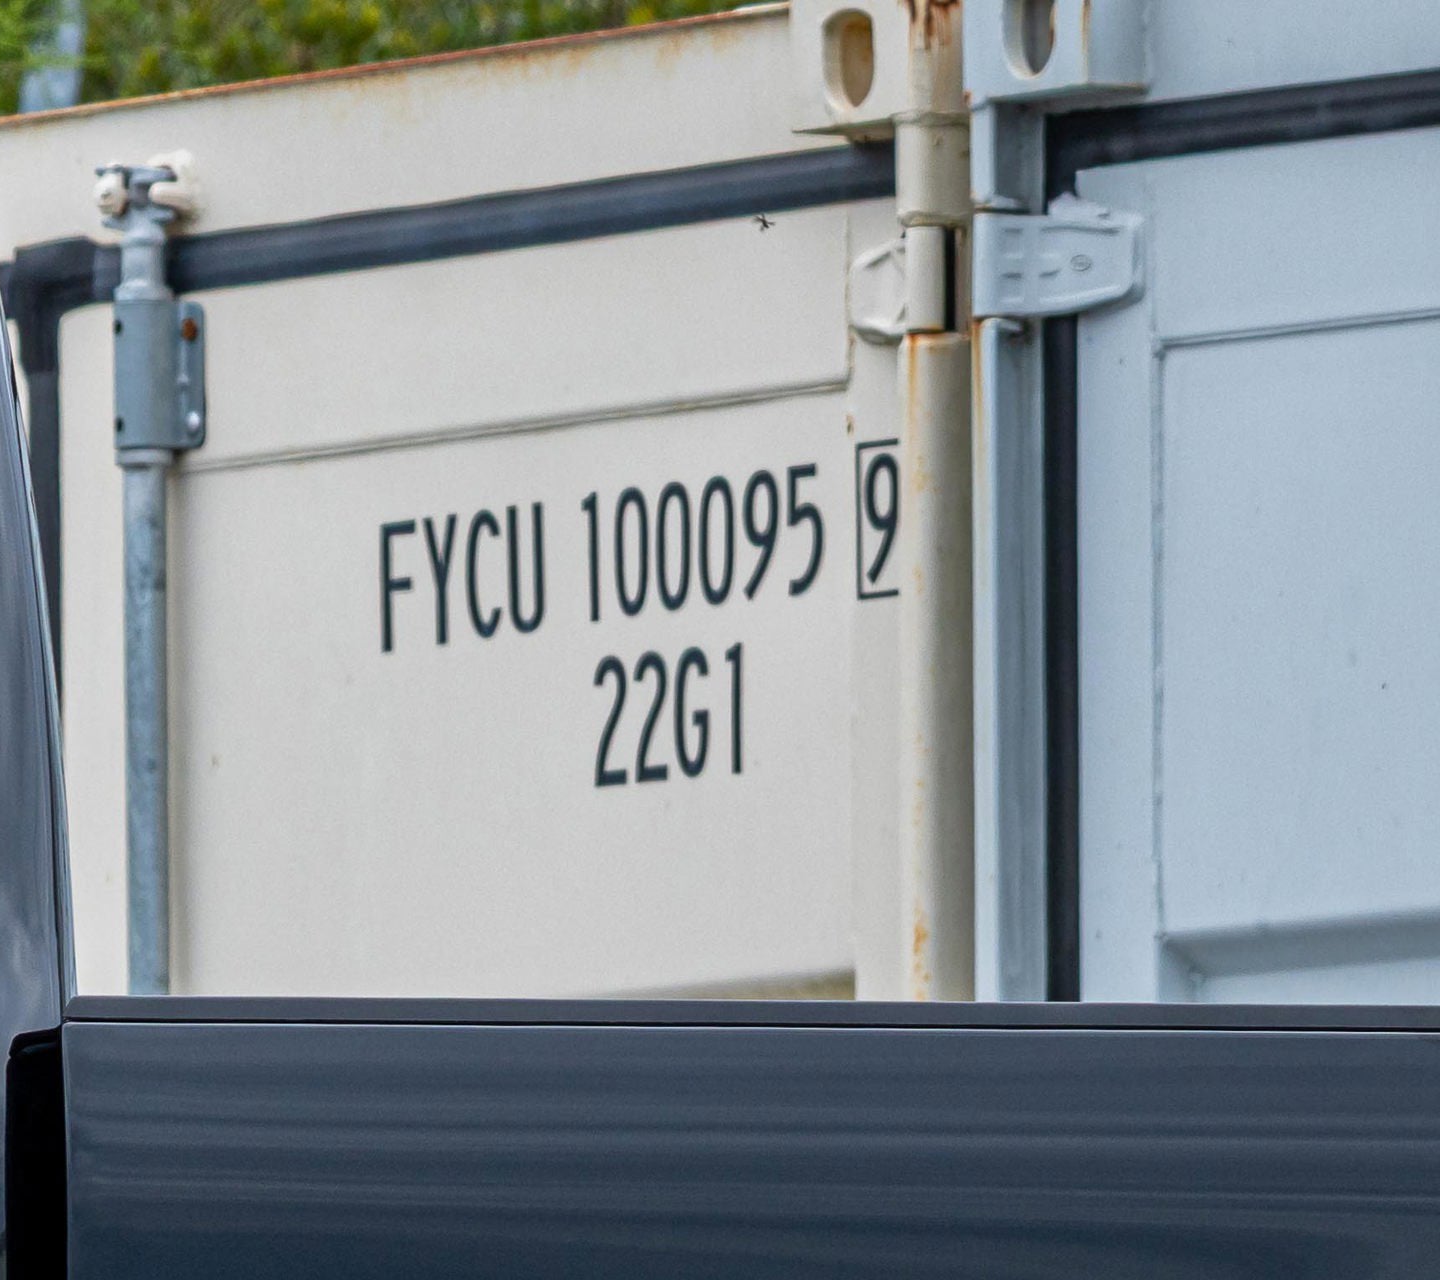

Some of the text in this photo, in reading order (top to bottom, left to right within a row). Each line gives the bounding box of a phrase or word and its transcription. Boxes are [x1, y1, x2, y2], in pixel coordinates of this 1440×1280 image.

[377, 454, 898, 654] FYCU 100095 9
[594, 642, 744, 788] 22G1
